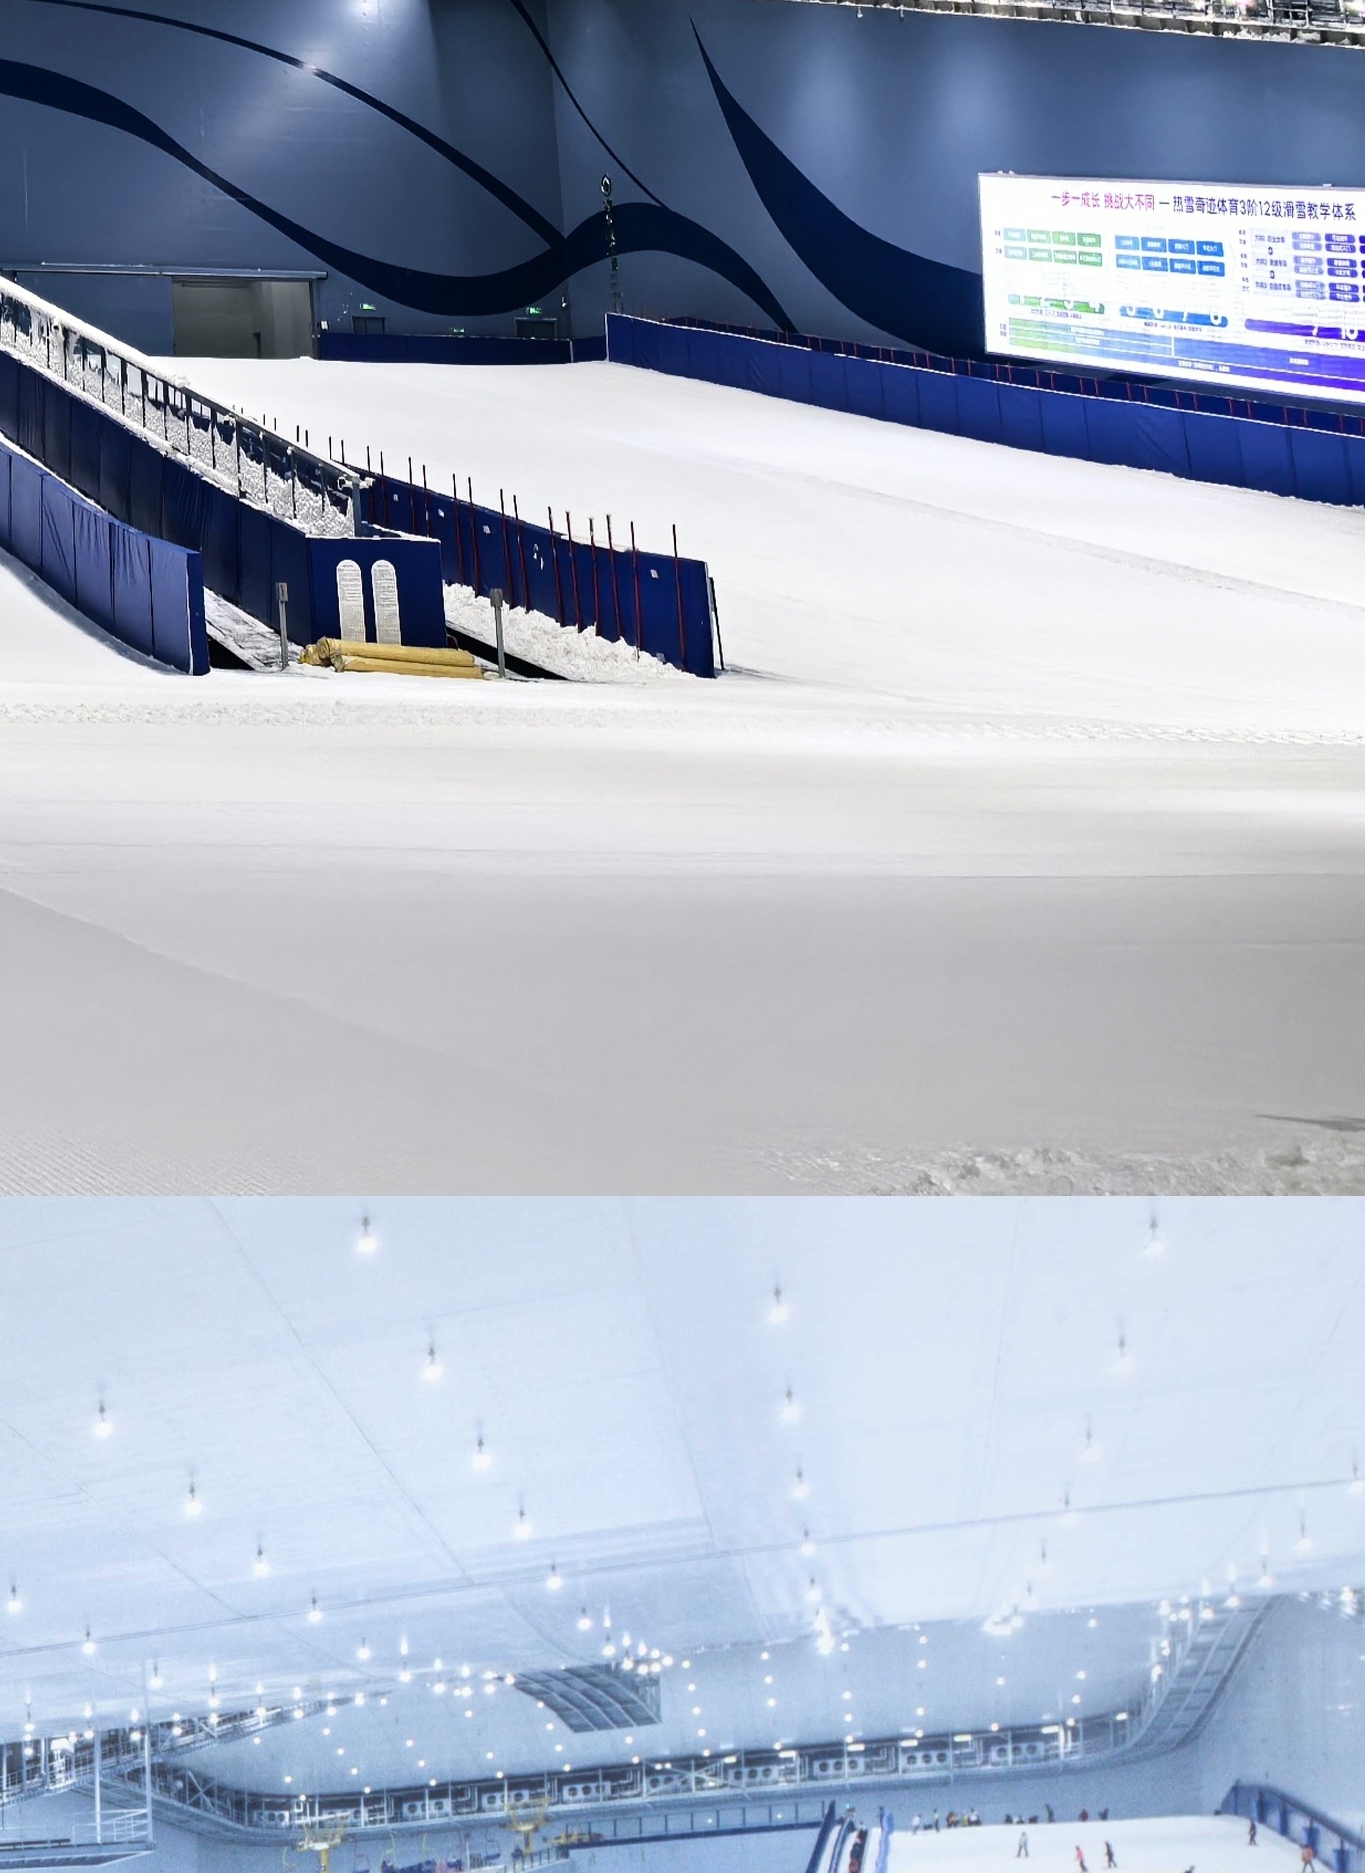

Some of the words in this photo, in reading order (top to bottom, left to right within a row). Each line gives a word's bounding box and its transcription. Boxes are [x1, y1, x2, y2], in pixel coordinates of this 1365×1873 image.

[1051, 191, 1101, 209] 一步一成长
[1104, 192, 1155, 211] 挑战大不同
[1173, 195, 1357, 221] 热雪奇迹体育3阶12级滑雪教学体系
